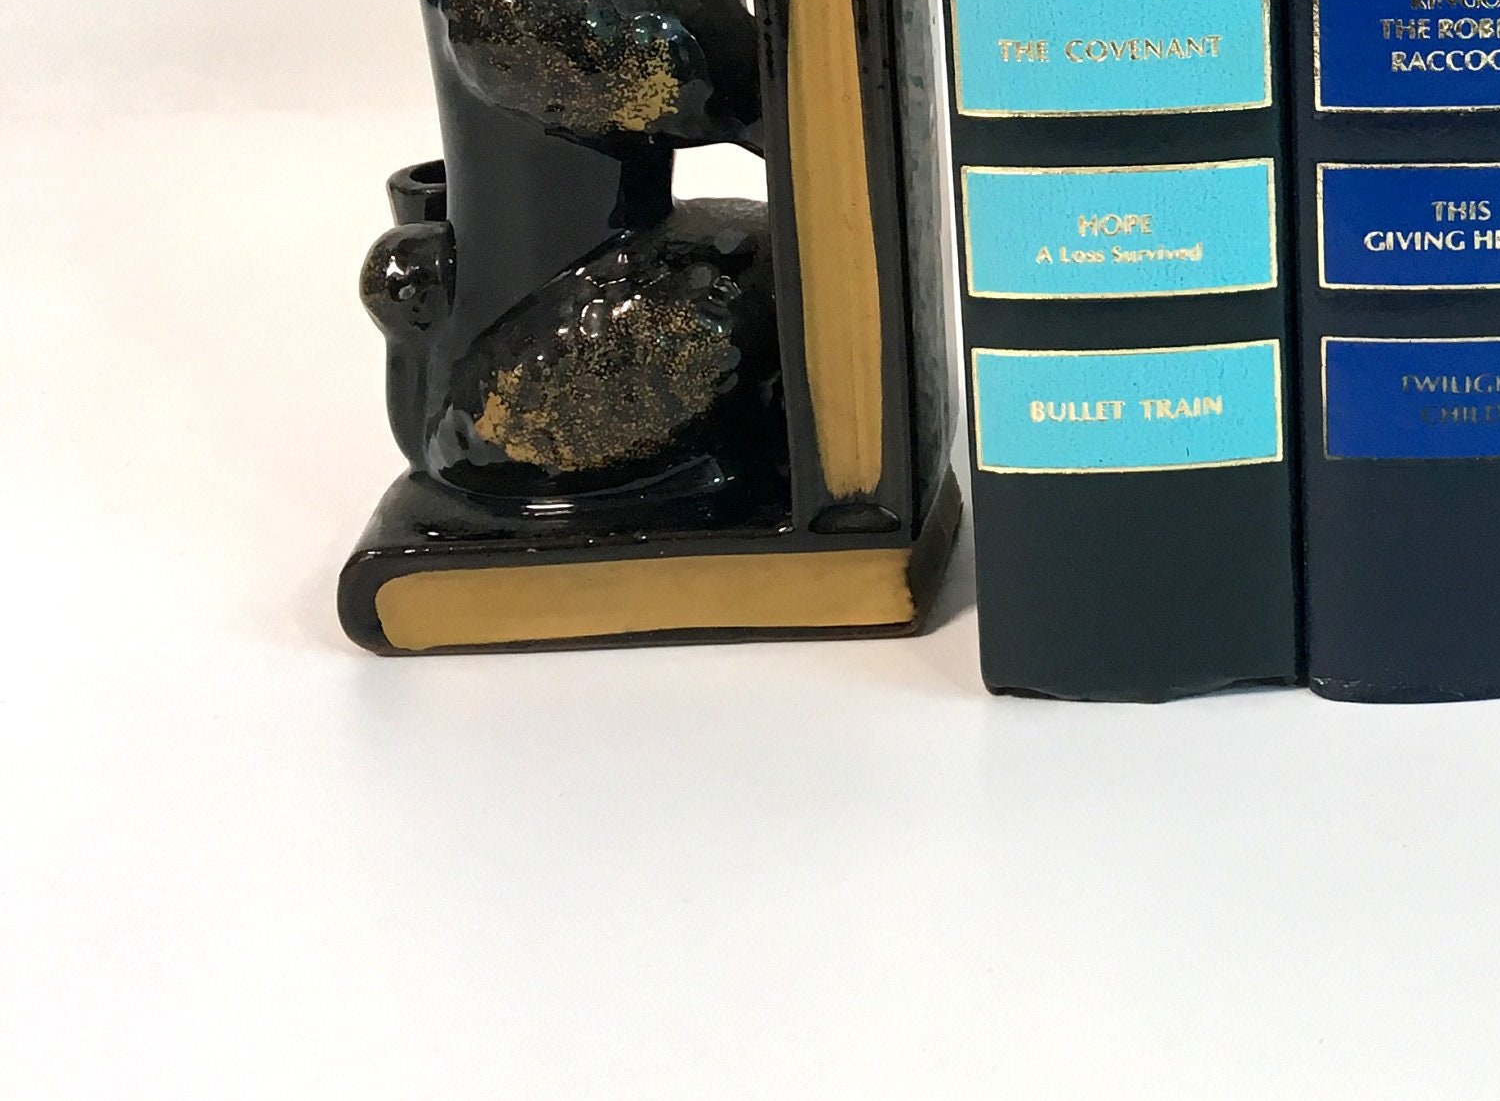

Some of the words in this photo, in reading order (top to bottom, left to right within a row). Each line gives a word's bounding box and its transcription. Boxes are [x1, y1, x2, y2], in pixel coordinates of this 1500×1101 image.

[1380, 18, 1430, 39] THE
[998, 39, 1049, 63] THE
[1065, 35, 1222, 63] COVENANT
[1432, 200, 1491, 222] THIS
[1078, 214, 1153, 236] HOPE
[1364, 230, 1464, 251] GIVING
[1036, 246, 1052, 263] A
[1060, 247, 1105, 263] Loss
[1111, 243, 1203, 263] Survived
[1030, 401, 1125, 423] BULLET
[1139, 396, 1222, 419] TRAIN
